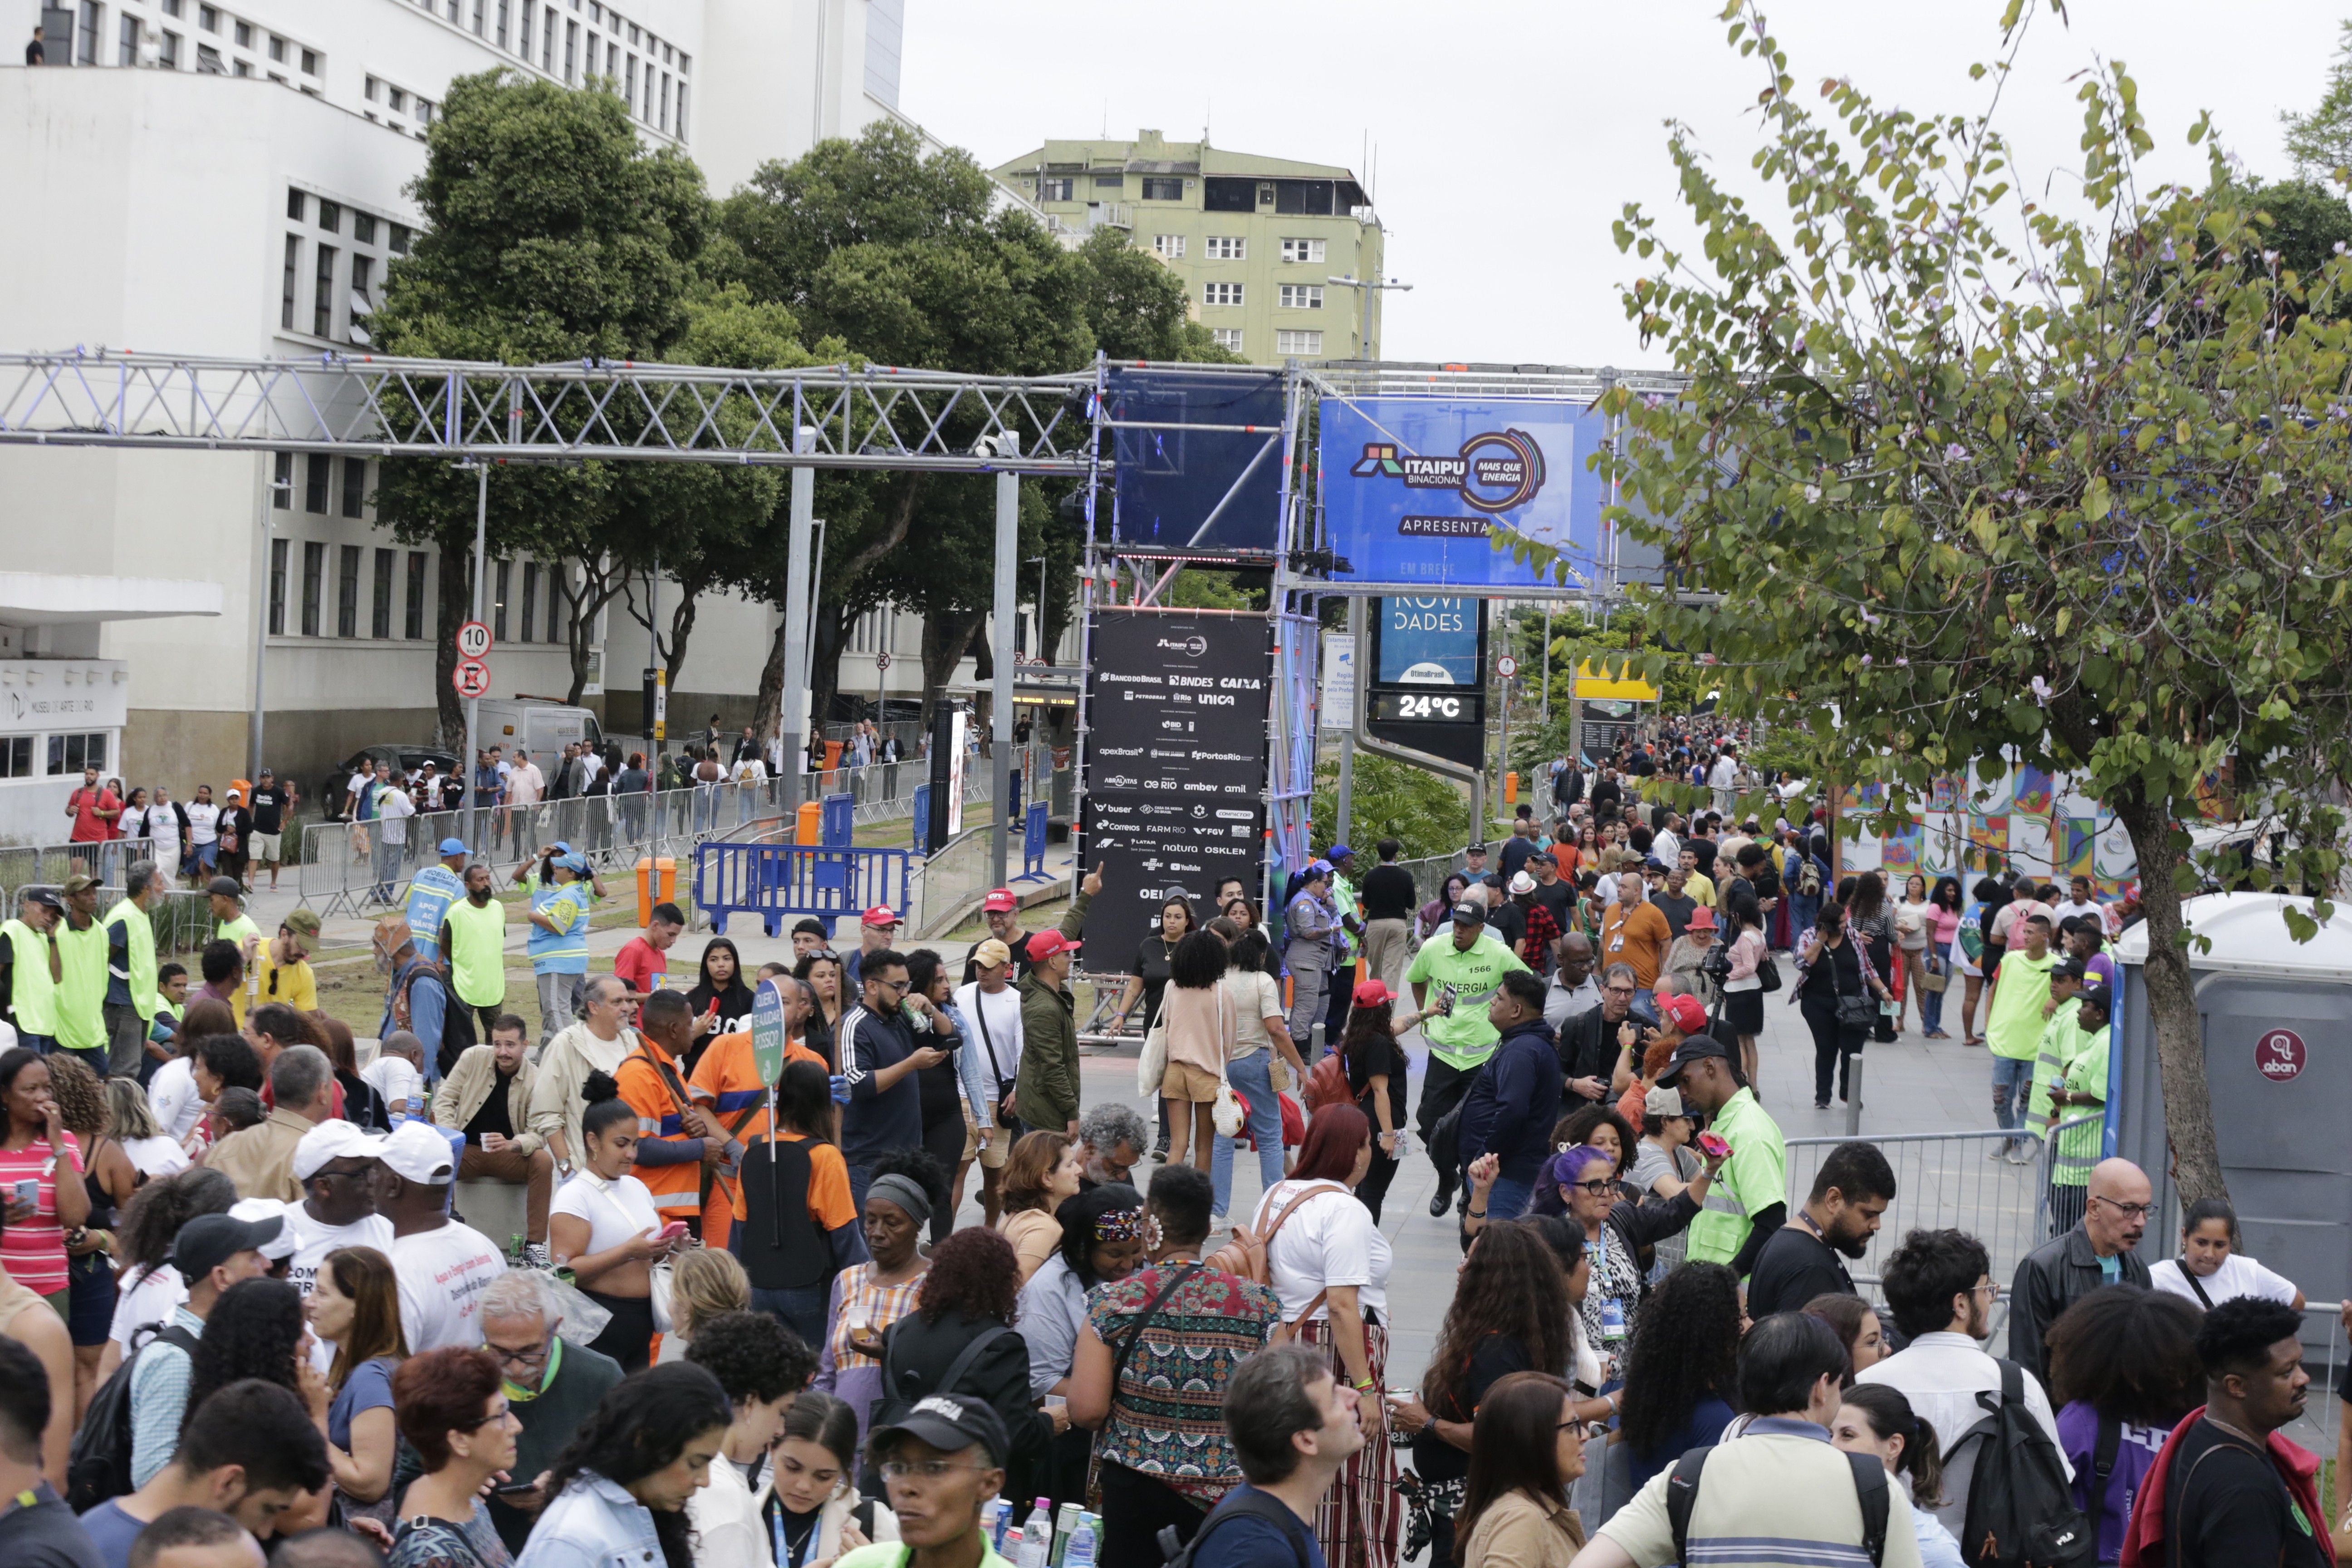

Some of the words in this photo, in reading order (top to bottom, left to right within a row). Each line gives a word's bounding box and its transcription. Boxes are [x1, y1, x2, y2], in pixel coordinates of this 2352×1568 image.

[1405, 460, 1465, 475] ITAIPU
[1478, 462, 1502, 472] MAIS
[1503, 463, 1522, 473] QUE
[1408, 475, 1462, 485] BINACIONAL
[1482, 472, 1521, 482] ENERGIA
[1403, 520, 1489, 534] APRESENTA
[1400, 562, 1417, 575] EM
[1395, 612, 1463, 632] DADES
[466, 628, 484, 646] 10
[1110, 674, 1132, 682] BANCO
[1141, 675, 1163, 683] BRASIL
[1180, 676, 1214, 688] BNDES
[1220, 677, 1261, 690] CAIXA
[32, 701, 50, 713] MUSEU
[60, 700, 74, 712] ARTE
[84, 700, 94, 712] RIO
[1099, 748, 1139, 756] apexBrasil
[1201, 752, 1241, 761] PortosRio
[1161, 781, 1177, 790] RIO
[1184, 782, 1218, 792] ambev
[1225, 785, 1246, 793] amil
[1107, 804, 1132, 813] buser
[1109, 823, 1140, 832] Correios
[1162, 844, 1198, 853] natura
[1205, 847, 1246, 855] OSKLEN
[425, 869, 459, 883] MOBILITY
[1140, 888, 1163, 900] OEI
[1456, 903, 1473, 914] SYNERGIA
[1469, 965, 1491, 974] 1566
[756, 990, 776, 1008] QUERO
[754, 1029, 779, 1051] POSSO?
